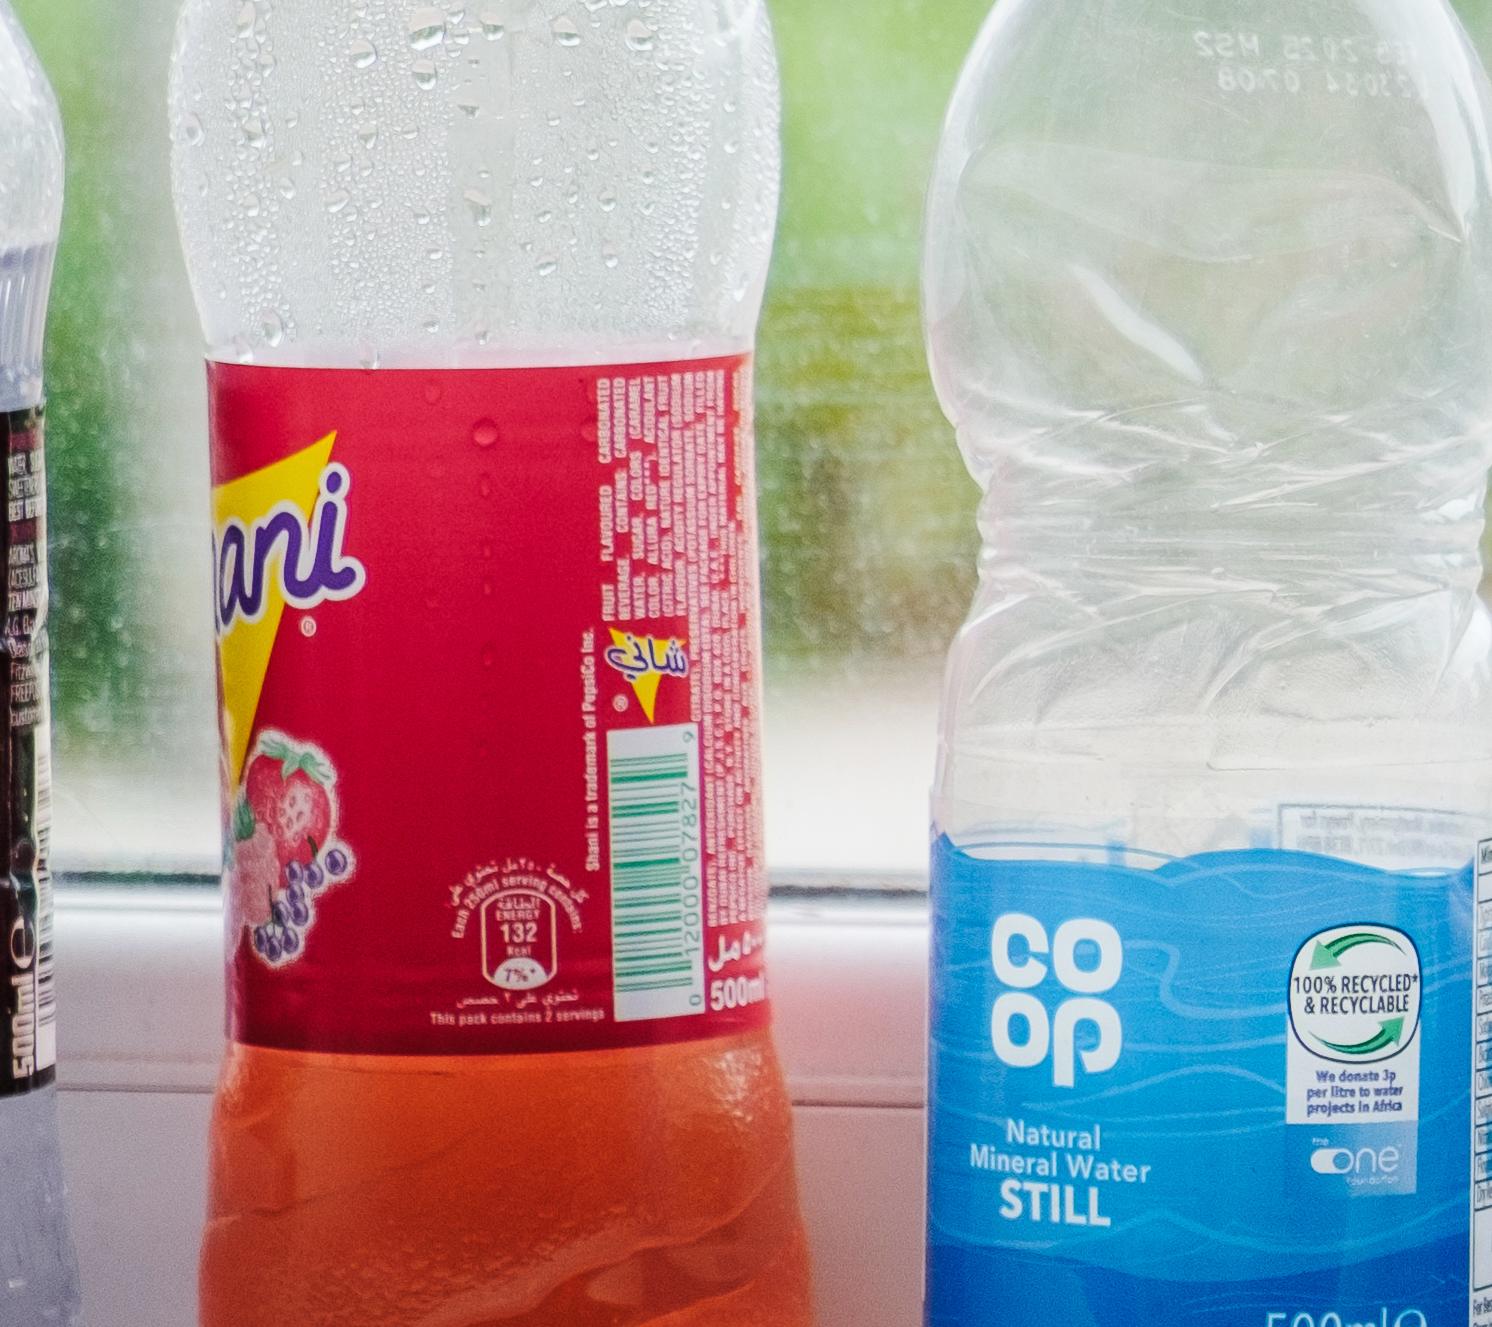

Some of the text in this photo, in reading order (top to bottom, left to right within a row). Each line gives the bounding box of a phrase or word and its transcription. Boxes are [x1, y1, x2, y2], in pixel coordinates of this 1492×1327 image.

[212, 469, 360, 634] ani
[580, 628, 600, 871] Shani is a trademark of PepsiCo Inc.
[680, 782, 700, 863] 07827
[502, 875, 548, 893] serving
[496, 910, 542, 922] ENERGY
[501, 923, 539, 943] 132
[1293, 976, 1337, 994] 100%
[1304, 994, 1409, 1015] & RECYCLABLE
[10, 975, 34, 1079] 500ml
[430, 1008, 606, 1027] This pack contains 2 servings
[1315, 1069, 1396, 1086] We donate 3p
[1306, 1085, 1404, 1101] per litre to water
[1306, 1099, 1403, 1117] projects in Africa
[1006, 1120, 1101, 1150] Natural
[970, 1145, 1151, 1185] Mineral Water
[1000, 1179, 1111, 1228] STILL
